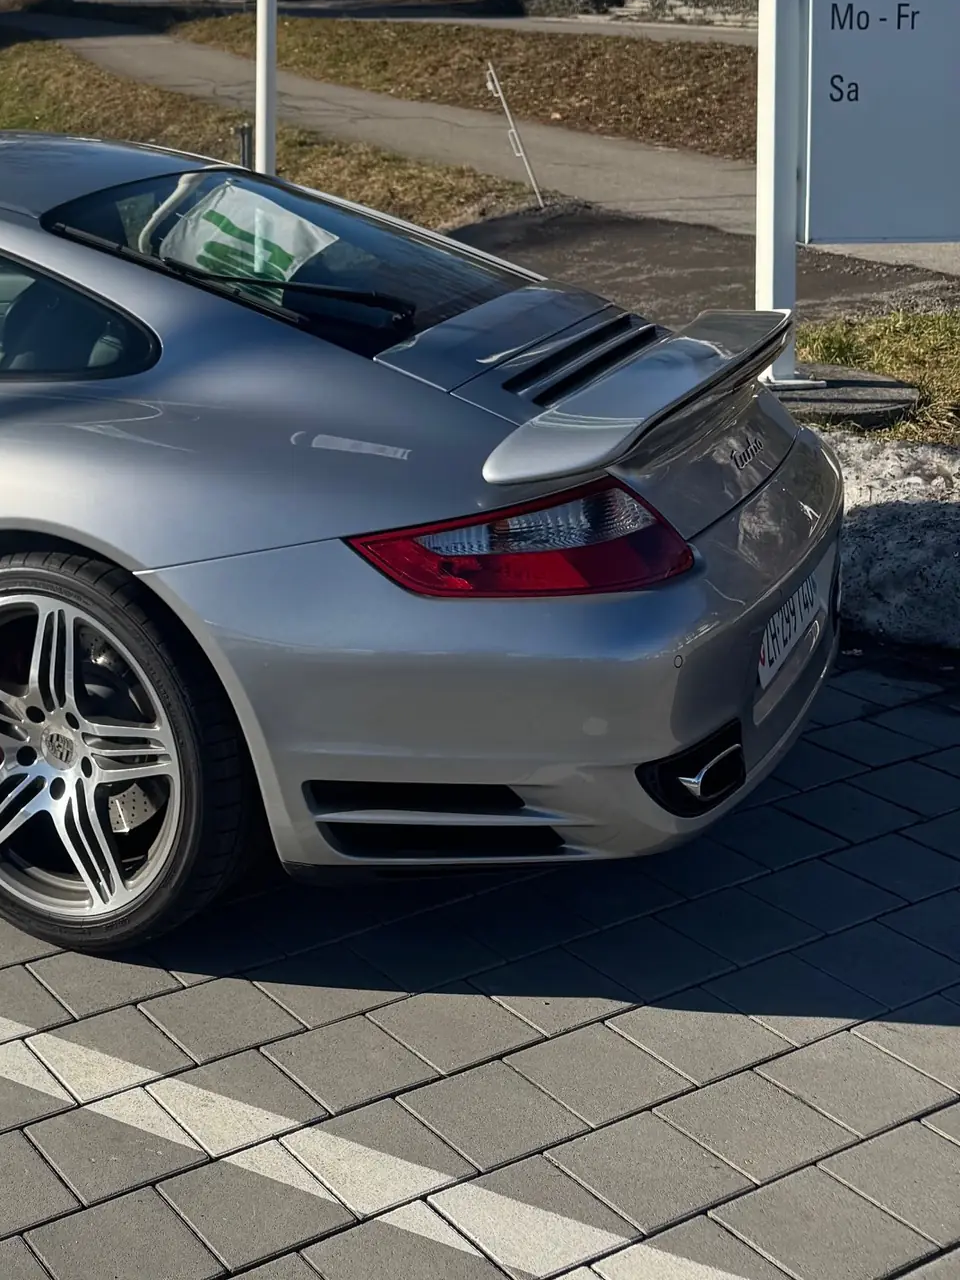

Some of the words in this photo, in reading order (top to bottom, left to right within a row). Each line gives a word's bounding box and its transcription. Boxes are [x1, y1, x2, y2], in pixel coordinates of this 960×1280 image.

[830, 3, 870, 31] Mo
[896, 3, 920, 31] Fr
[829, 74, 860, 102] Sa
